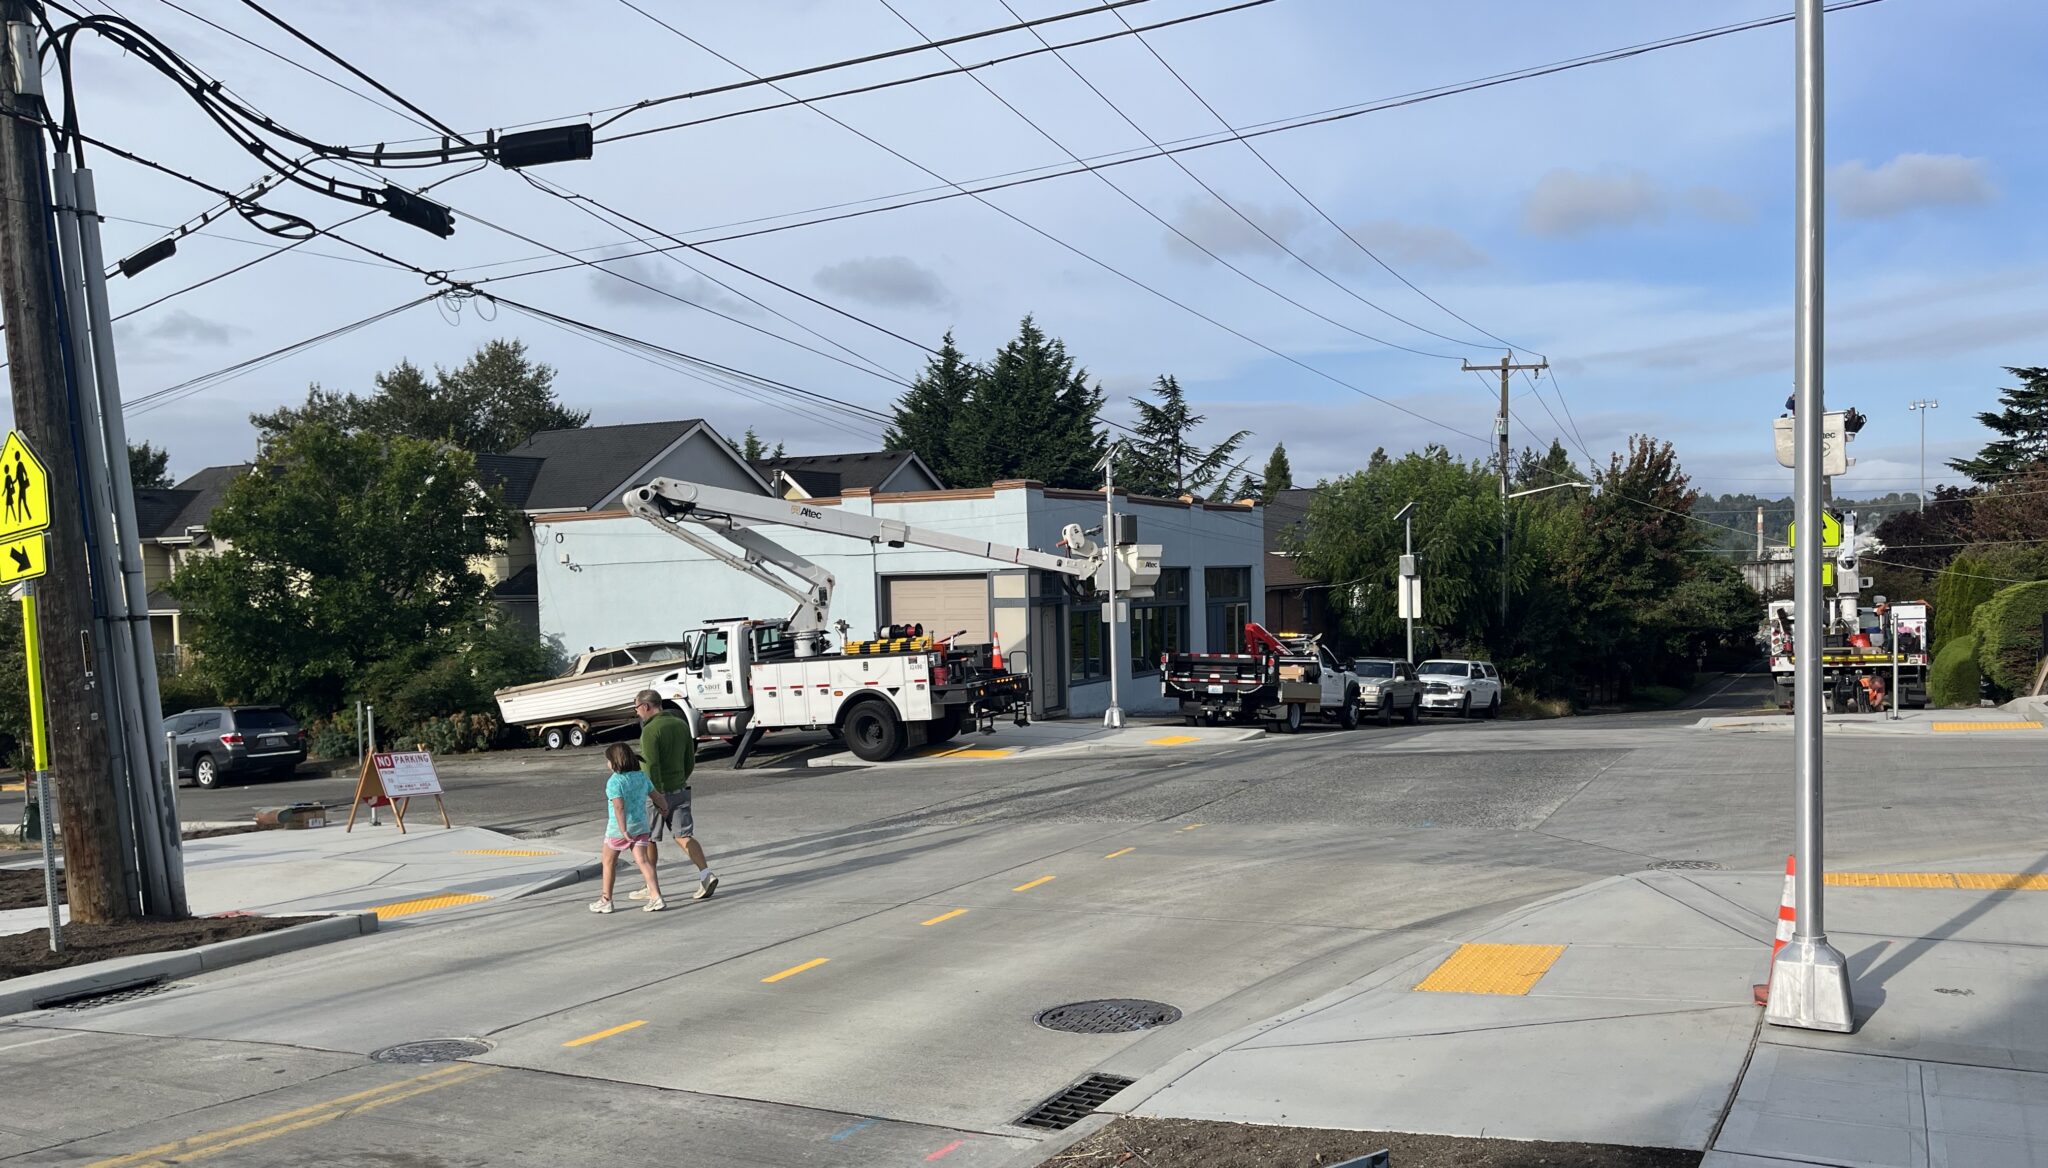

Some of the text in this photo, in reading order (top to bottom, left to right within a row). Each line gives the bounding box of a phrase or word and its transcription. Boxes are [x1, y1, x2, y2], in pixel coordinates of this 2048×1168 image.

[800, 507, 822, 519] Altec
[376, 755, 429, 767] NO PARKING
